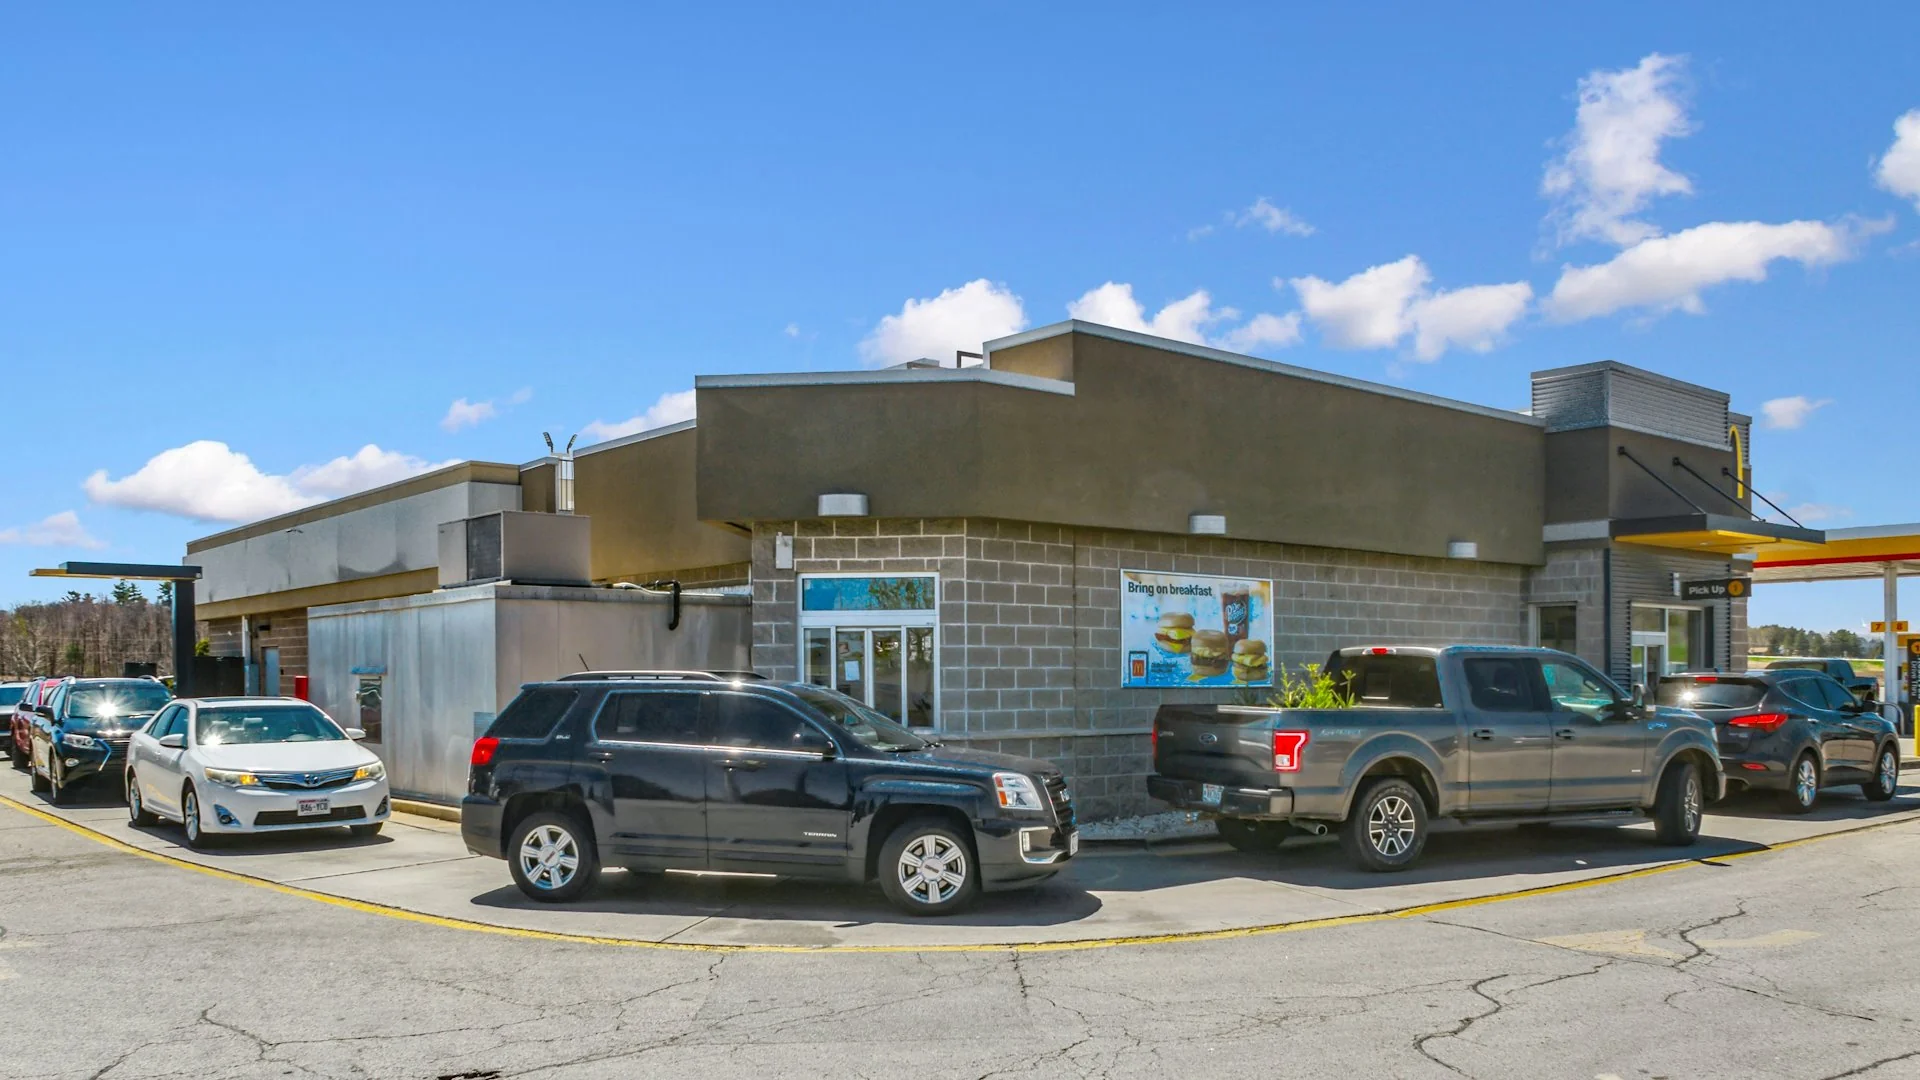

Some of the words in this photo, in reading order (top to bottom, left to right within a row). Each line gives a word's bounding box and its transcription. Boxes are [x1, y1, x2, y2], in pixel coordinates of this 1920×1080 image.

[1128, 582, 1154, 596] Bring
[1156, 585, 1168, 594] on
[1170, 584, 1212, 596] breakfast
[1688, 586, 1709, 595] Pick
[1711, 585, 1725, 594] Up
[1875, 623, 1882, 631] 7
